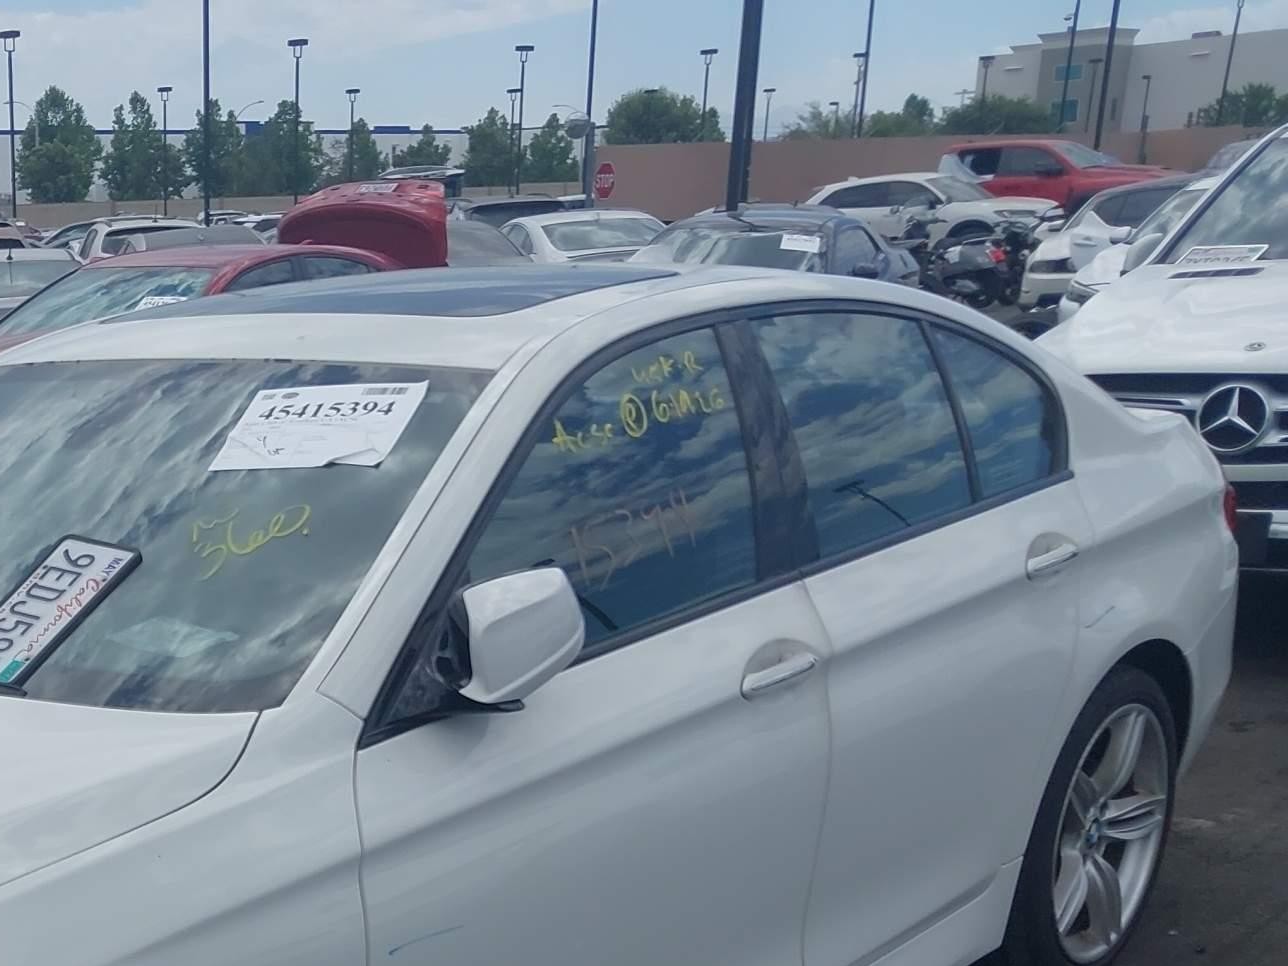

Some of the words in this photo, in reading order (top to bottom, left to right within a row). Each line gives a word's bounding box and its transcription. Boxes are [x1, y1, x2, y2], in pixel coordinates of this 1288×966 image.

[595, 174, 614, 188] STOP
[258, 400, 396, 420] 45415394
[100, 556, 123, 577] MAY
[14, 577, 102, 658] California
